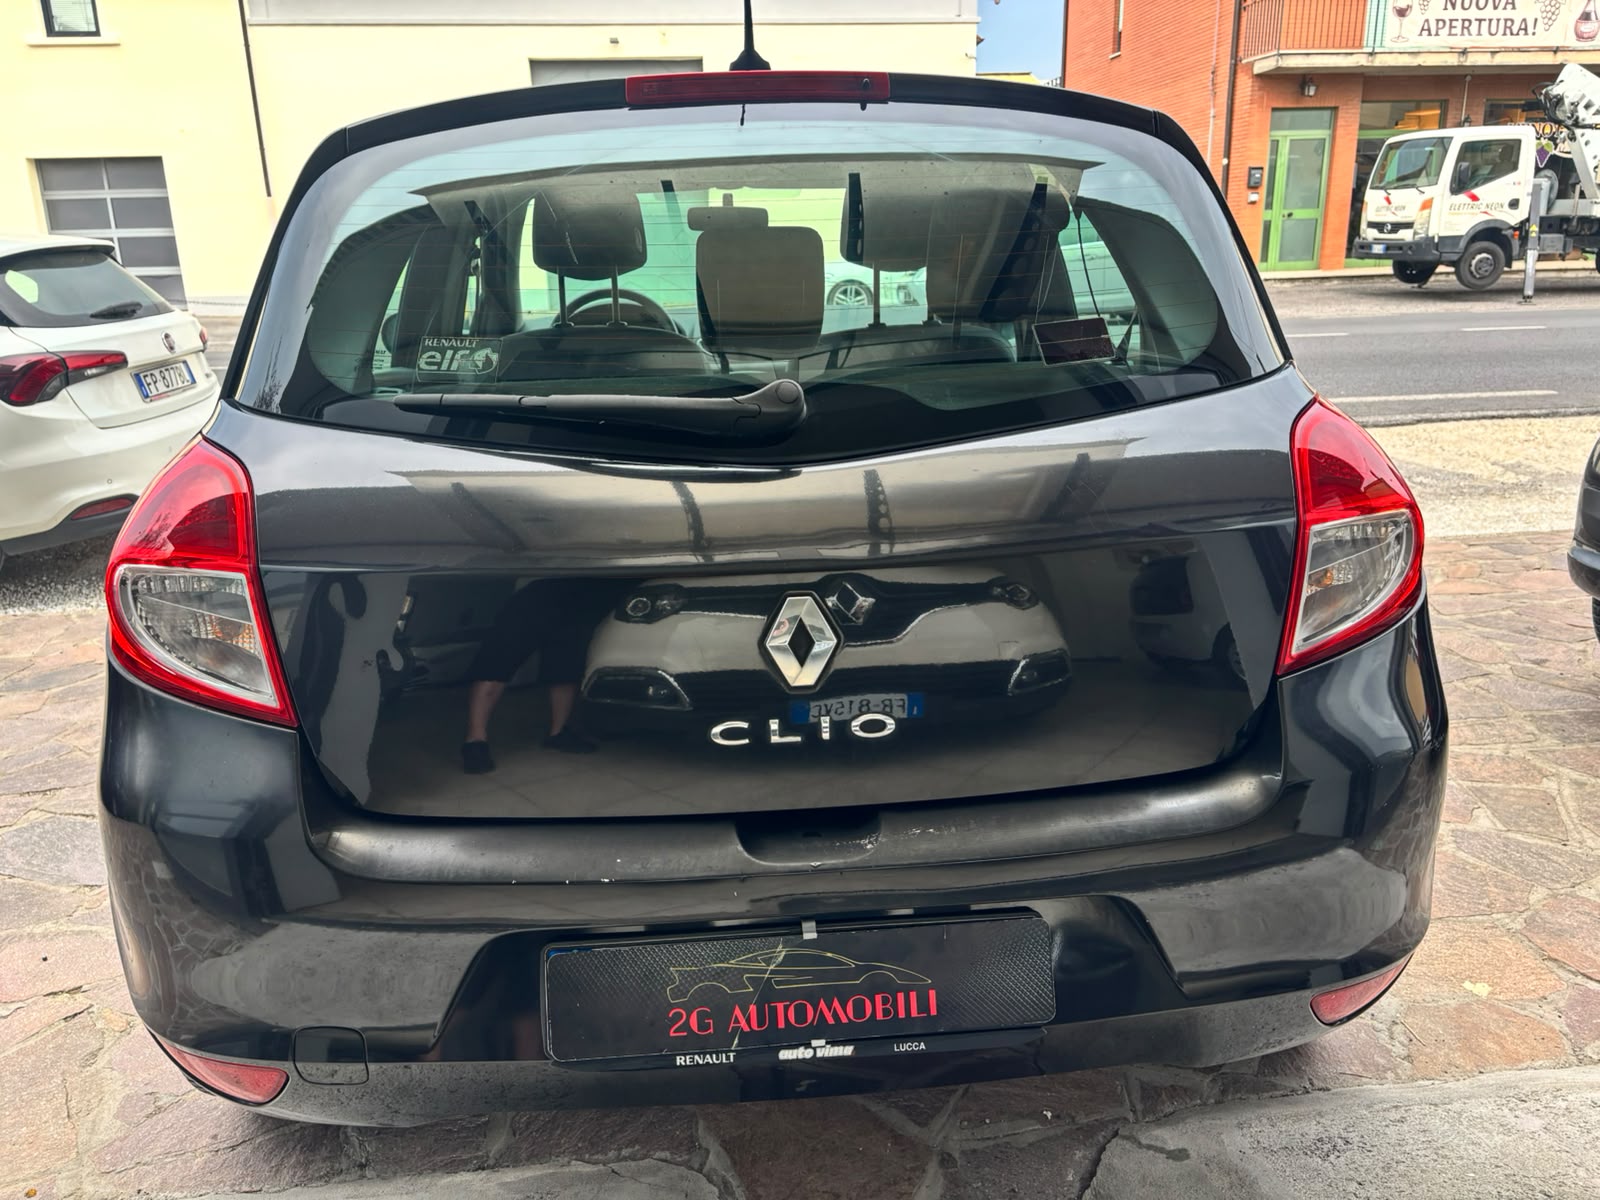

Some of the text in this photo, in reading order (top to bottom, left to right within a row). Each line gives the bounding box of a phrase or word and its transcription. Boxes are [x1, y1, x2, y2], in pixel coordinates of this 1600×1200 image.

[1443, 0, 1517, 11] NUOVA
[1418, 18, 1538, 36] APERTURA!
[1448, 202, 1505, 211] ELETTRIC NEON
[424, 338, 479, 348] RENAULT
[418, 349, 470, 371] elf
[710, 712, 897, 746] CLIO
[667, 989, 938, 1037] 2G AUTOMOBILI
[676, 1052, 737, 1066] RENAULT
[893, 1041, 926, 1052] LUCCA
